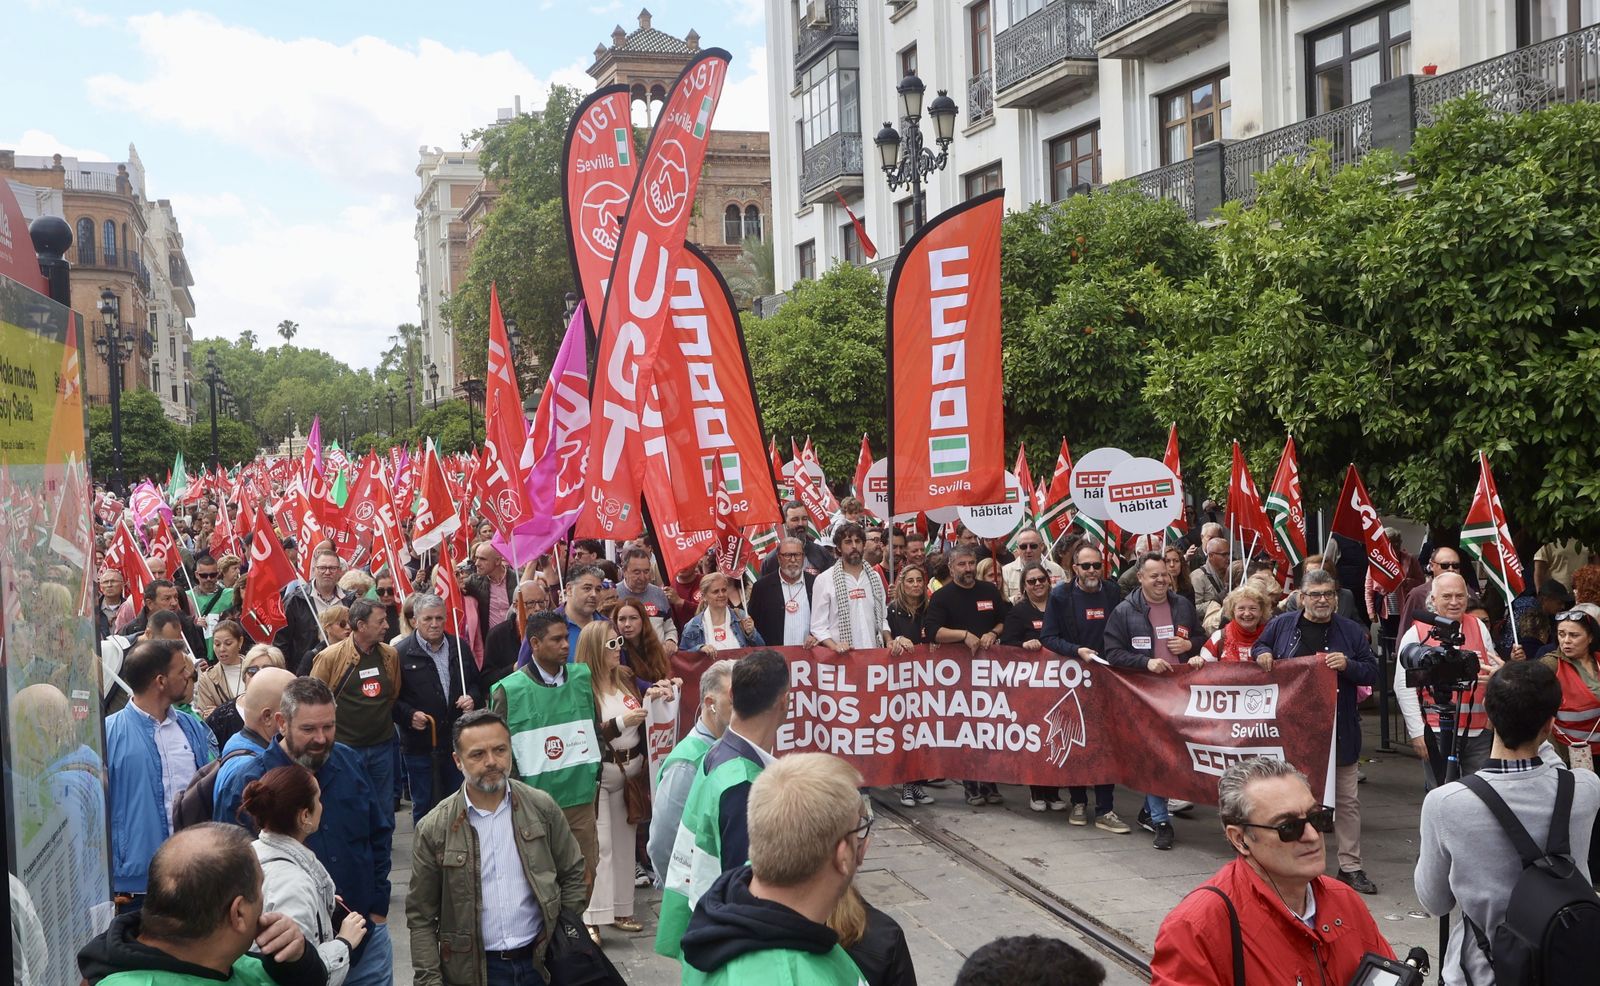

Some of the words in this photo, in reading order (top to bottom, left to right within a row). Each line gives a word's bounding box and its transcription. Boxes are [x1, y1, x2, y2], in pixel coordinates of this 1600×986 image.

[683, 60, 718, 98] UGT
[578, 96, 617, 144] UGT
[576, 154, 614, 174] Sevilla
[928, 246, 969, 430] CCOO
[871, 480, 888, 490] CC
[928, 479, 971, 496] Sevilla
[1111, 484, 1154, 499] CCOO
[800, 491, 825, 521] Sevilla
[971, 504, 1013, 518] hábitat
[1119, 497, 1168, 514] hábitat
[676, 529, 713, 551] Sevilla
[1370, 548, 1400, 576] Sevilla
[817, 662, 857, 692] EL
[867, 658, 961, 692] PLENO
[971, 658, 1092, 688] EMPLEO:
[363, 682, 379, 691] UGT
[869, 690, 1018, 724] JORNADA,
[1195, 690, 1241, 713] UGT
[776, 720, 896, 755] EJORES
[902, 720, 1041, 753] SALARIOS
[1231, 722, 1280, 738] Sevilla
[546, 739, 561, 749] UGT
[1192, 749, 1258, 771] CCO
